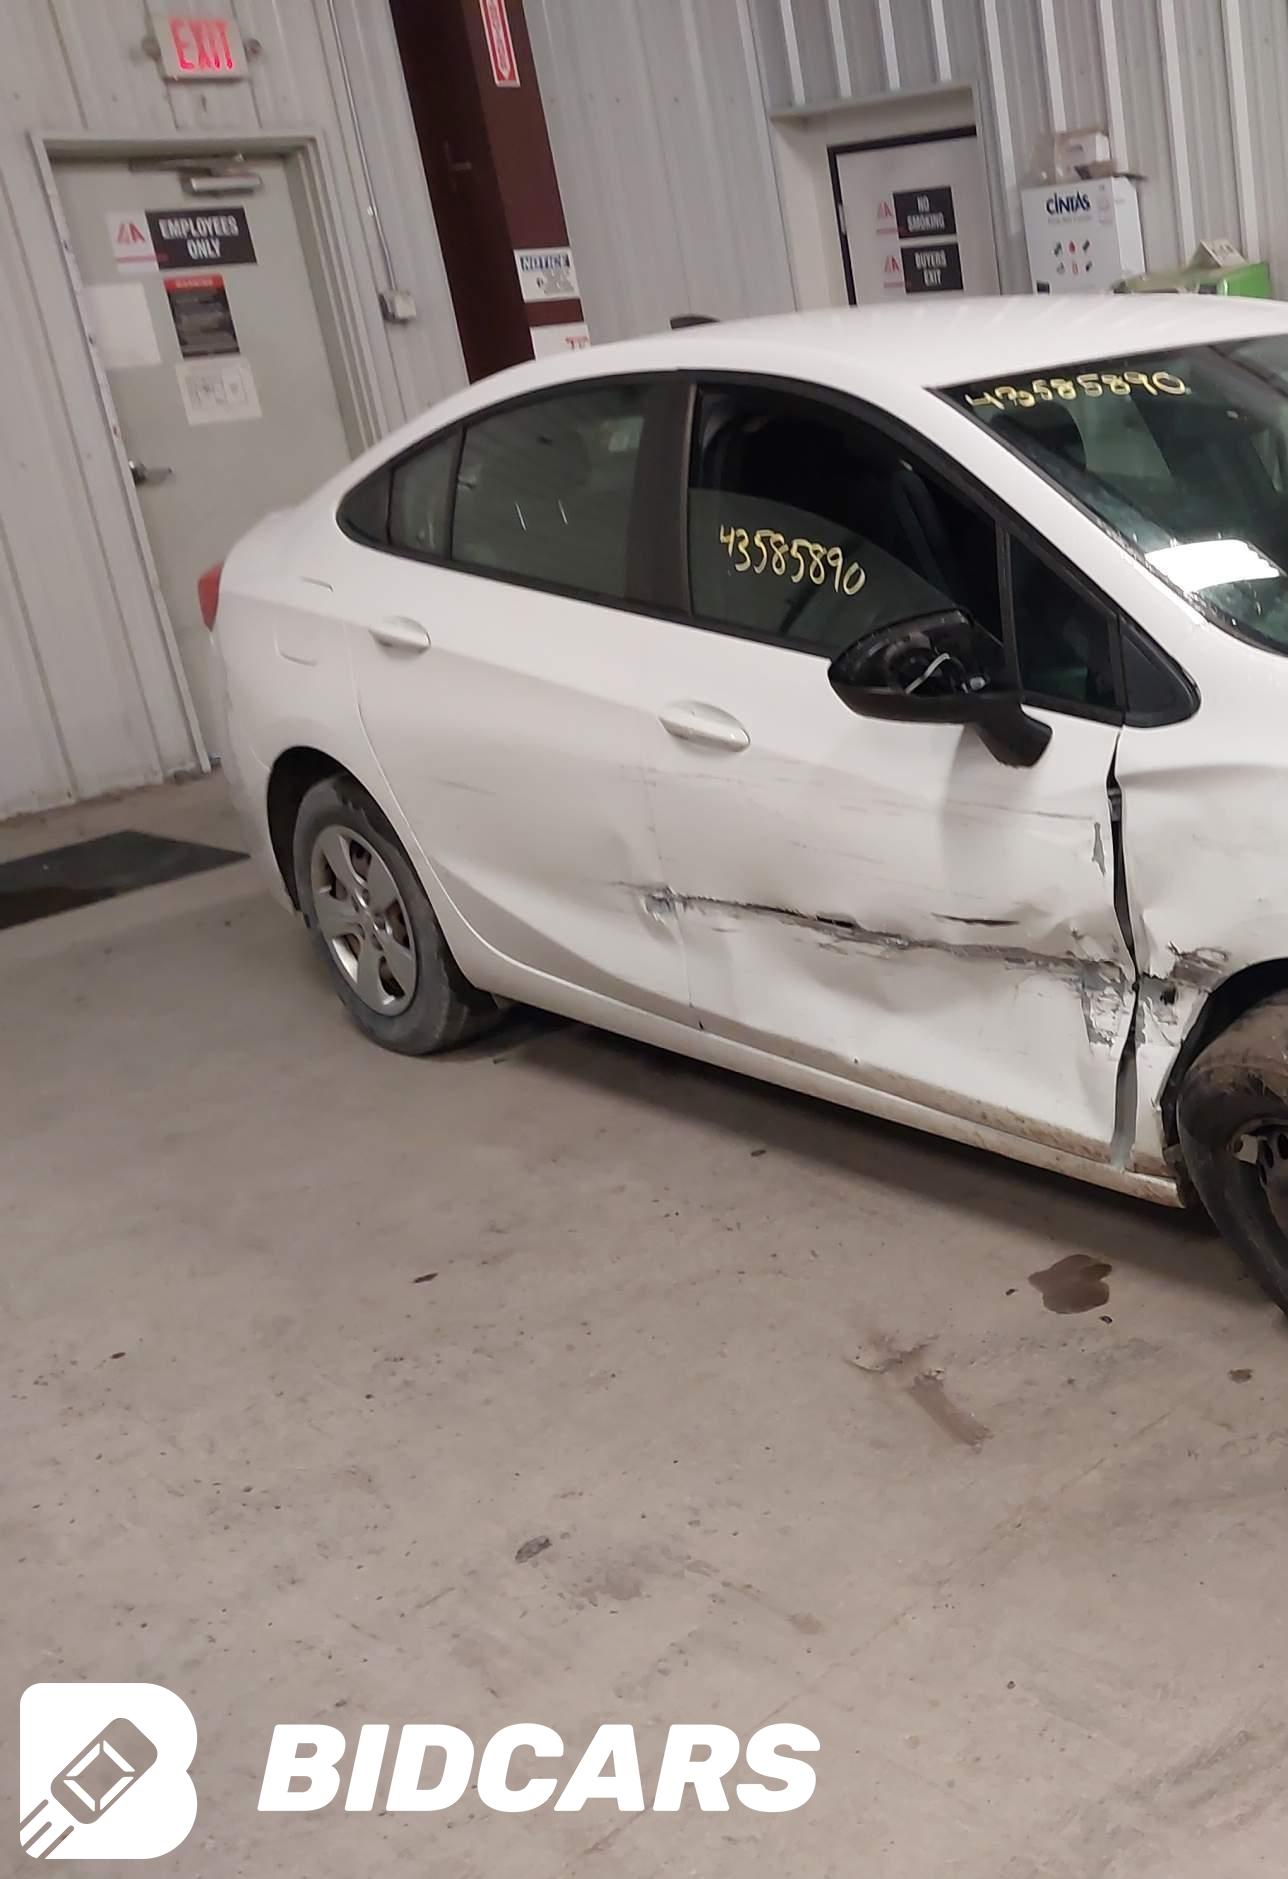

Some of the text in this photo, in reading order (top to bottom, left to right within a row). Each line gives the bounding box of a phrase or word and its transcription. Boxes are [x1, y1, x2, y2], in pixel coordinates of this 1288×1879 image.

[169, 19, 233, 70] EXIT
[917, 195, 930, 213] NO
[1046, 191, 1090, 215] CINTAS
[158, 215, 240, 240] EMPLOYEES
[907, 212, 945, 232] SMOKING
[186, 238, 221, 260] ONLY
[914, 250, 947, 269] BUYERS
[519, 254, 571, 272] NOTICE
[923, 268, 942, 287] EXIT
[965, 371, 1186, 411] 43585890
[719, 524, 866, 595] 43585890
